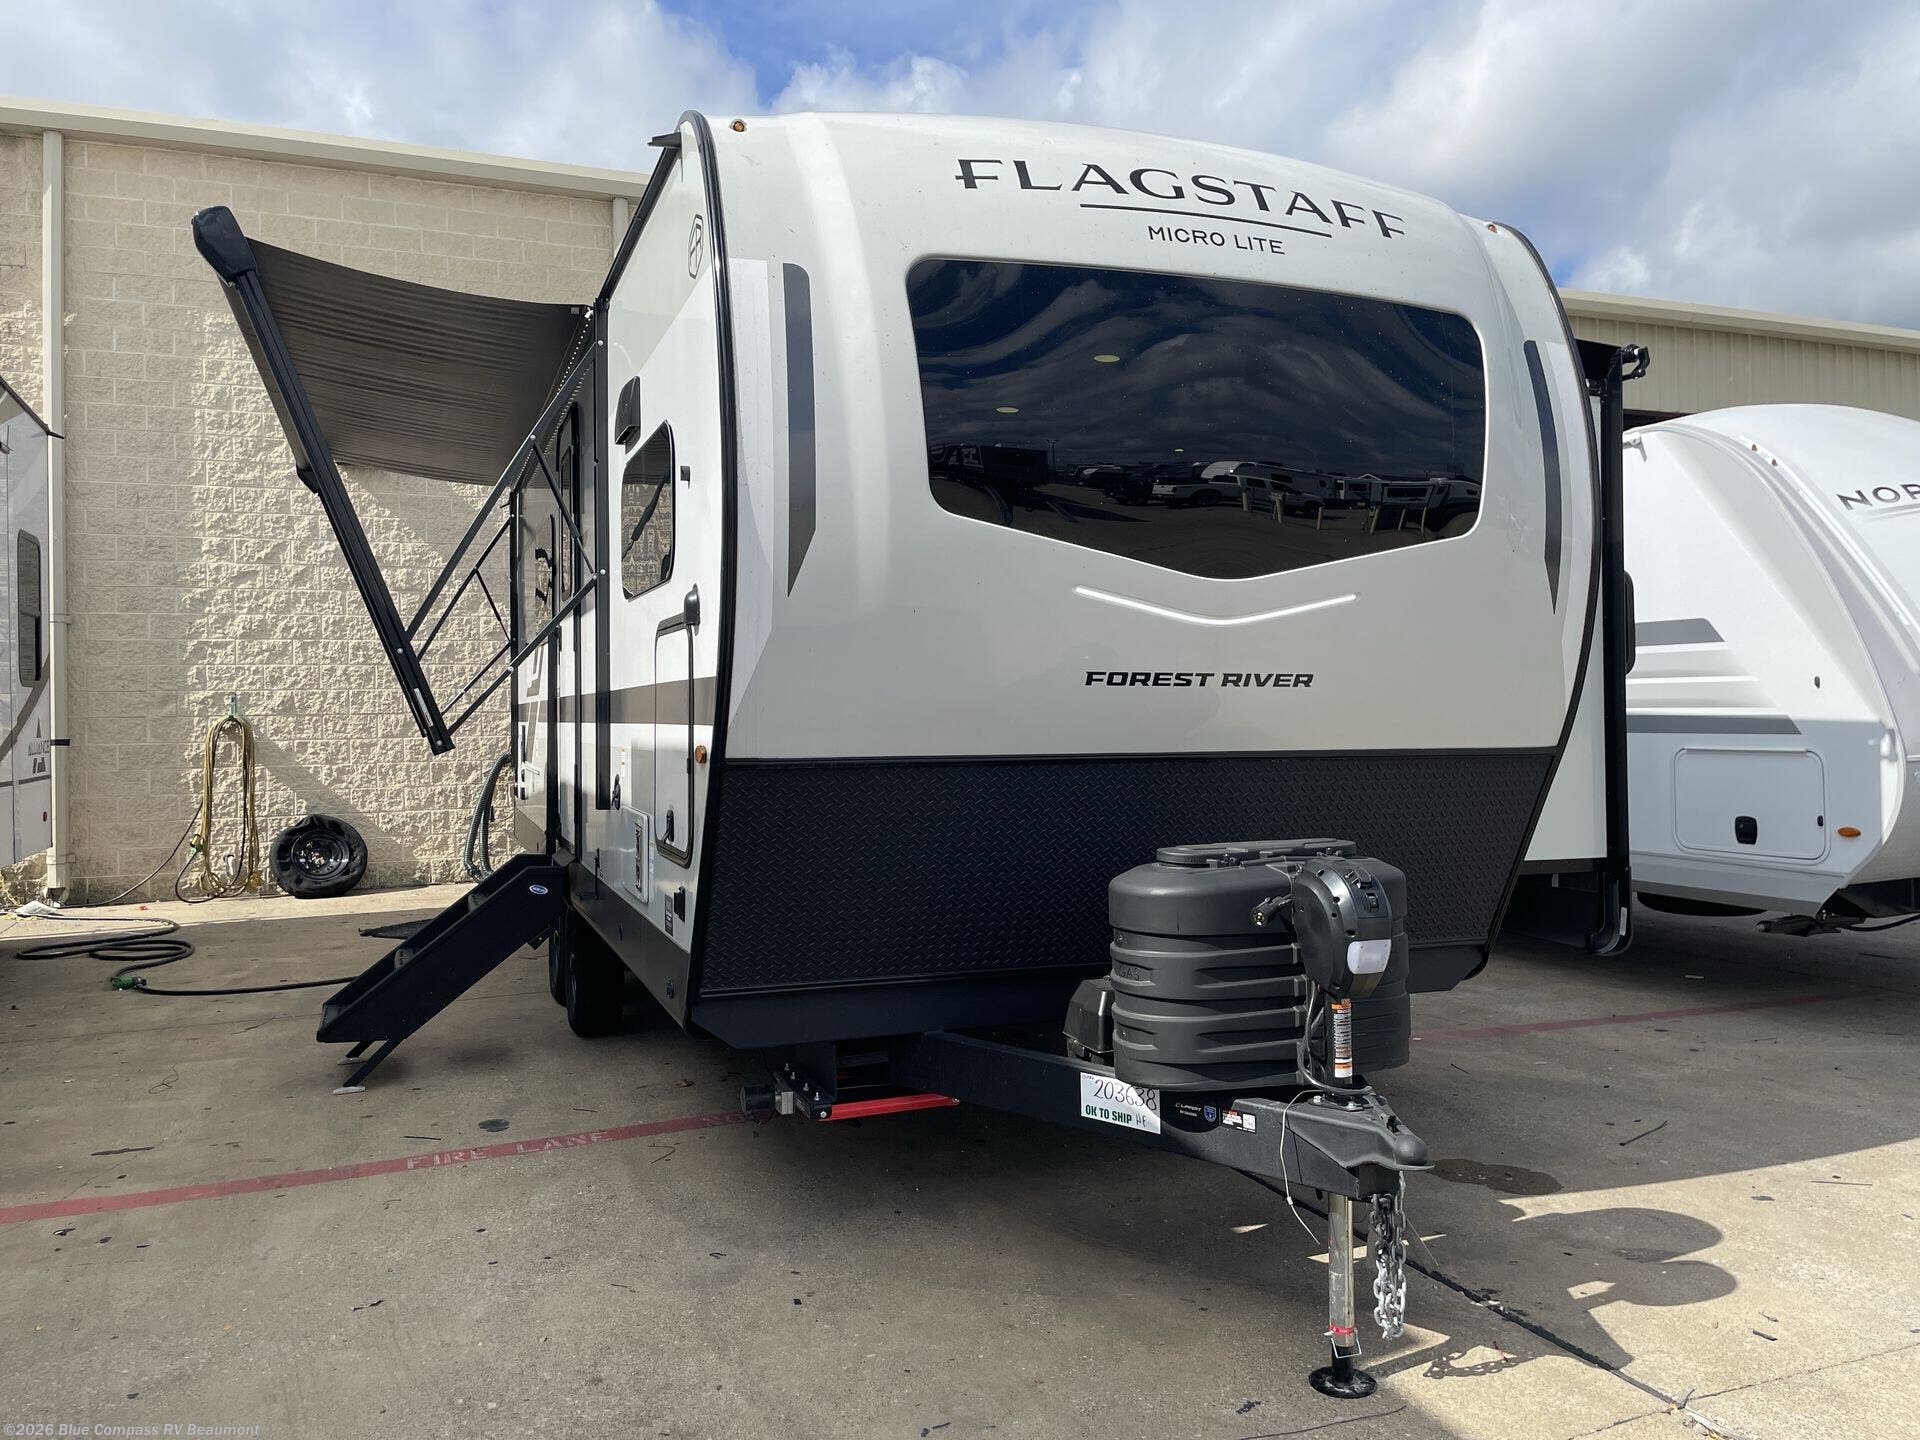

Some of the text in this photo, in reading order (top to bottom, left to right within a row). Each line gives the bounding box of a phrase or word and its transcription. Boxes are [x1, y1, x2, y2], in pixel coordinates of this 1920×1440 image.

[955, 158, 1405, 239] FLAGSTAFF
[1148, 225, 1285, 256] MICRO LITE
[1085, 671, 1314, 688] FOREST RIVER
[1093, 1079, 1157, 1111] 203638
[1085, 1104, 1132, 1124] OK TO SHIP
[406, 1132, 613, 1169] FIRE LANE
